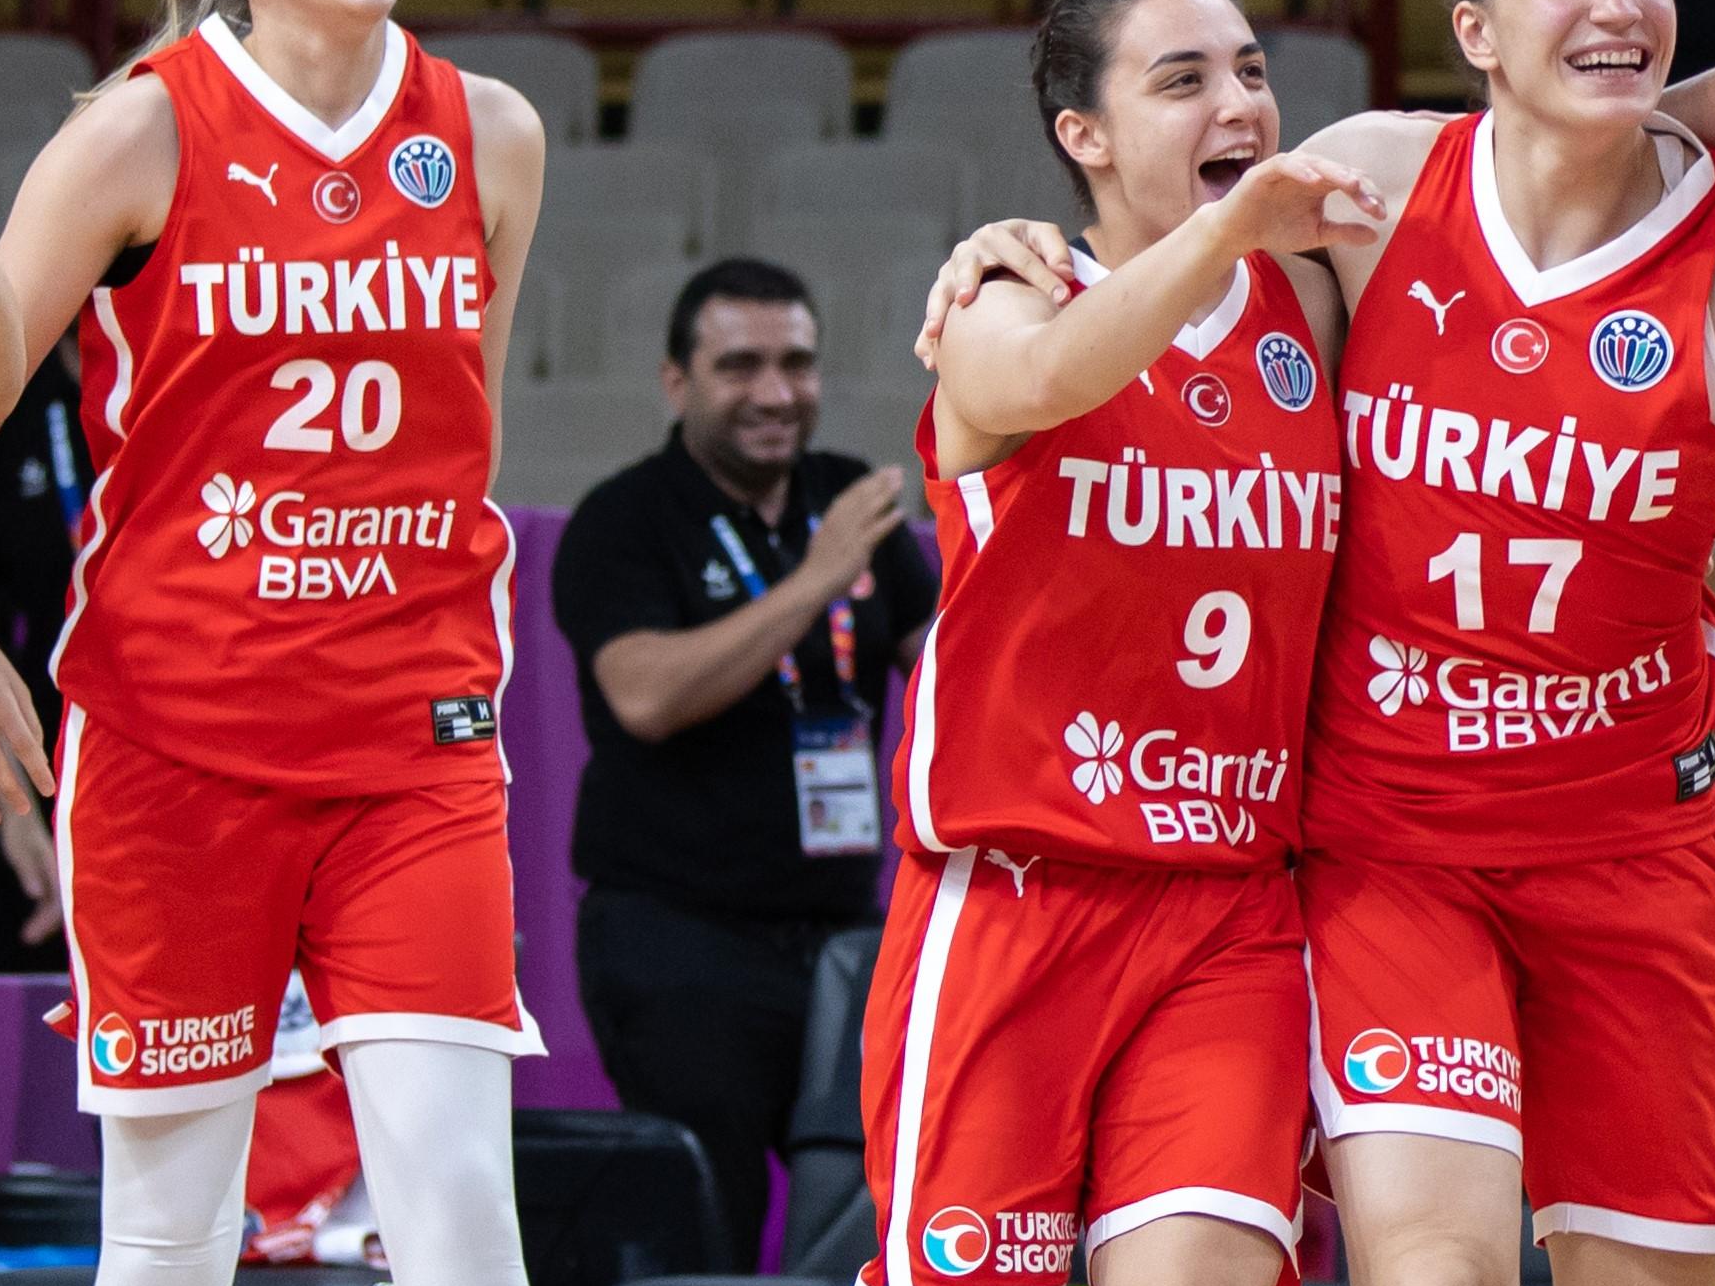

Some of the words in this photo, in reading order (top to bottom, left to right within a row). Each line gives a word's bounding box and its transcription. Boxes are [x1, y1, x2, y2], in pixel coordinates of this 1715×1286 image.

[180, 241, 481, 336] TÜRKİYE
[263, 359, 402, 454] 20
[1342, 382, 1681, 523] TÜRKİYE
[260, 491, 456, 551] Garanti
[1059, 448, 1341, 552] TÜRKİYE
[257, 552, 397, 601] BBVA
[1428, 532, 1584, 634] 17
[1176, 590, 1252, 689] 9
[1436, 641, 1671, 710] Garanti
[1448, 708, 1615, 752] BBVA
